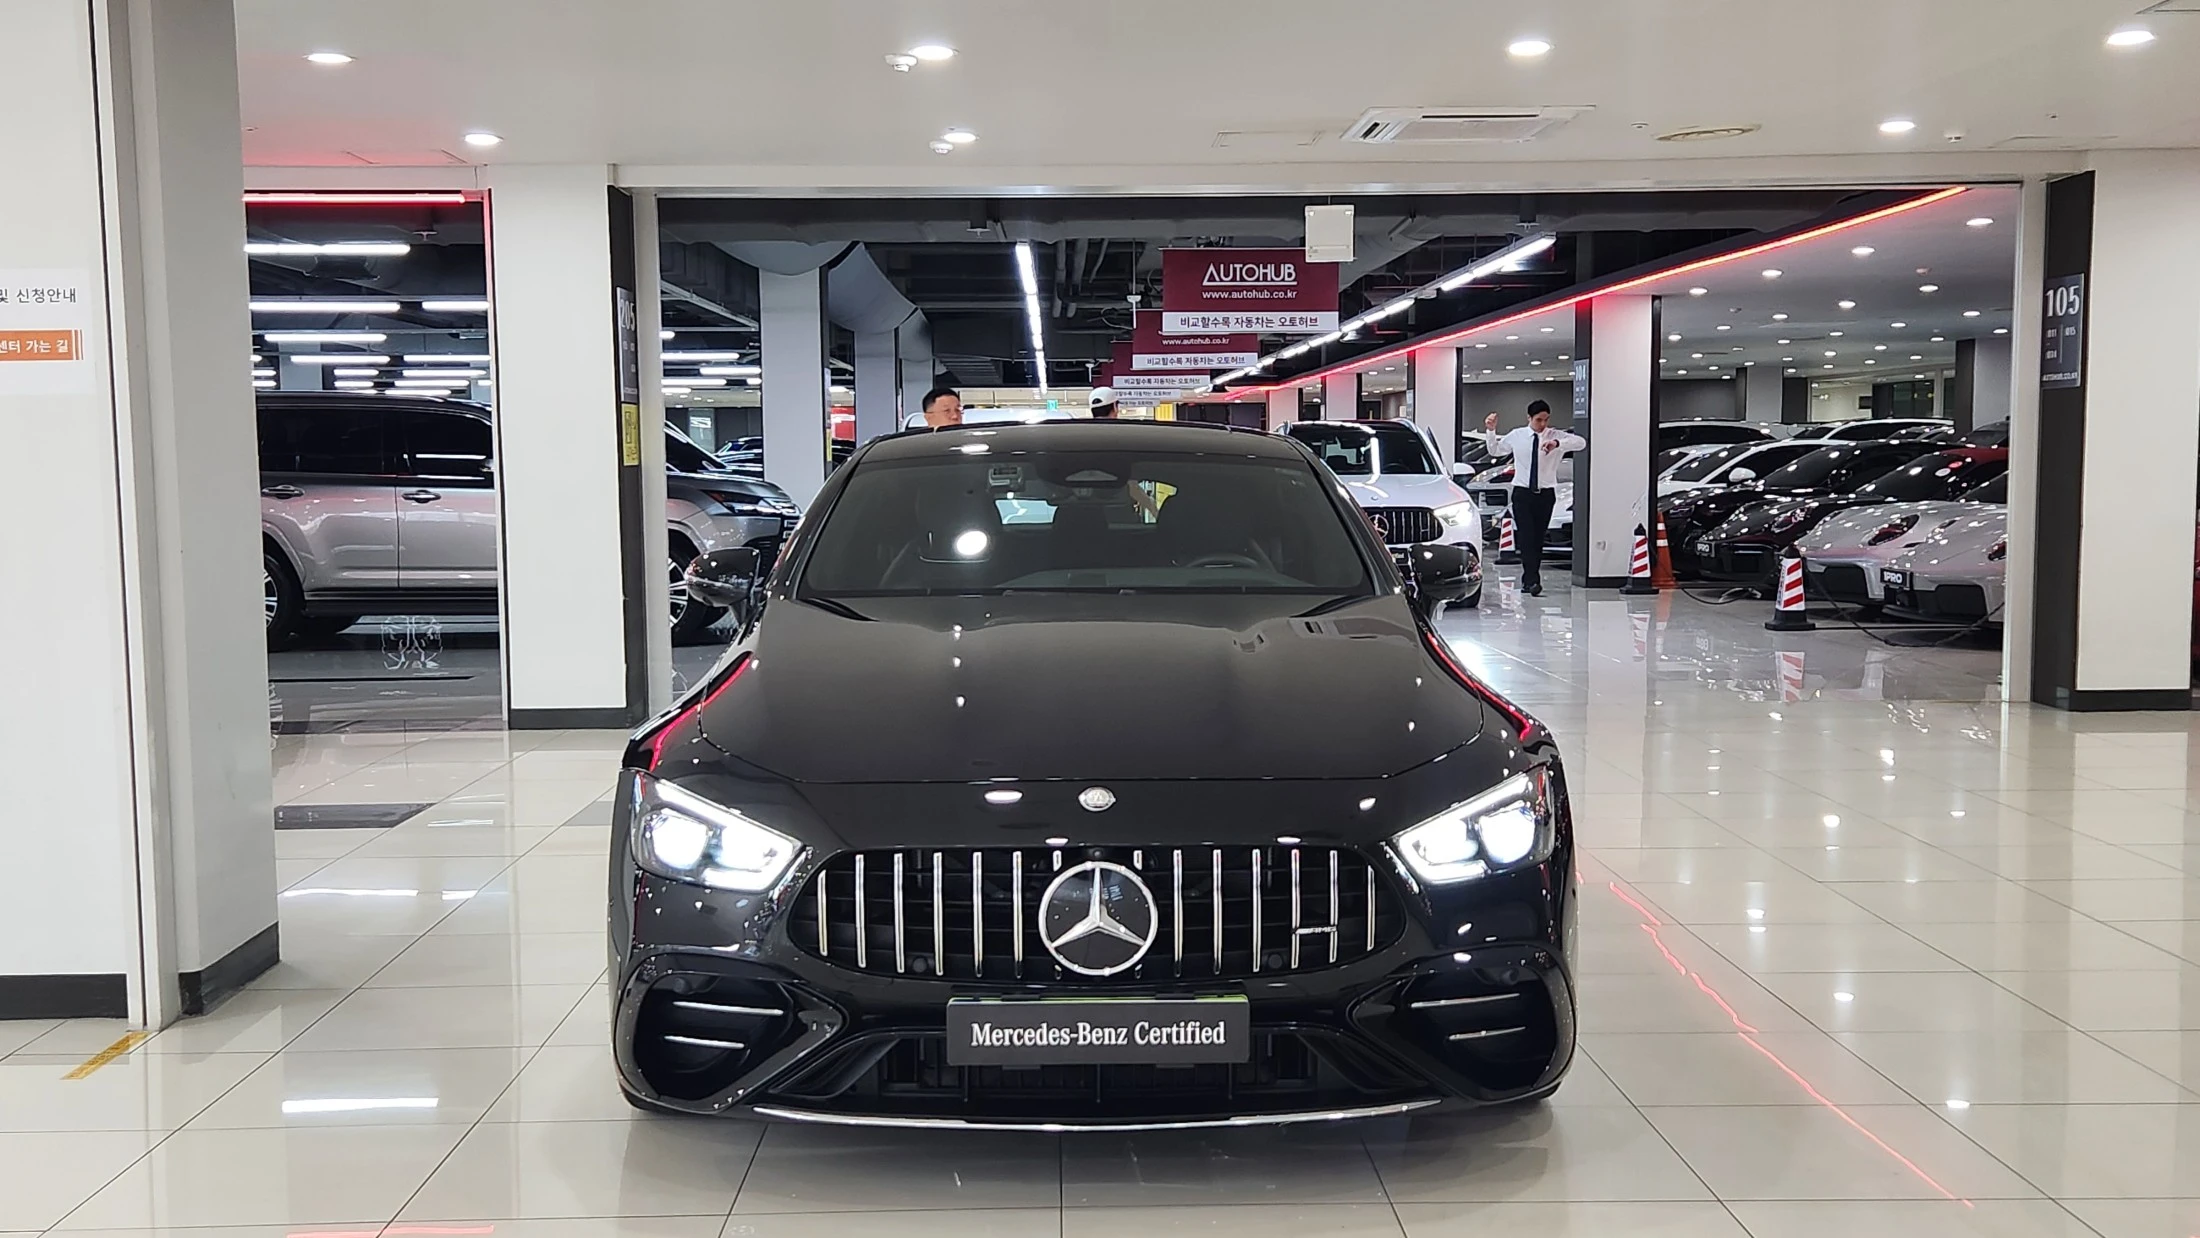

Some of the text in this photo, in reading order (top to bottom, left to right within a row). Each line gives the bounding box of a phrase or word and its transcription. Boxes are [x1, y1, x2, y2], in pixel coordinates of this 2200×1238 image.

[1202, 263, 1298, 286] AUTOHUB
[16, 288, 76, 303] 신청안내
[1202, 289, 1298, 299] www.autohub.co.kr
[2045, 285, 2080, 317] 105
[1180, 315, 1319, 329] 비교할수록 자동차는 오토허브
[25, 340, 52, 354] 가는
[56, 339, 69, 353] 길
[1162, 337, 1230, 346] www.autohub.co.kr
[1147, 355, 1246, 366] 비교할수록 자동차는 오토허브
[970, 1020, 1226, 1047] Mercedes-Benz Certified
